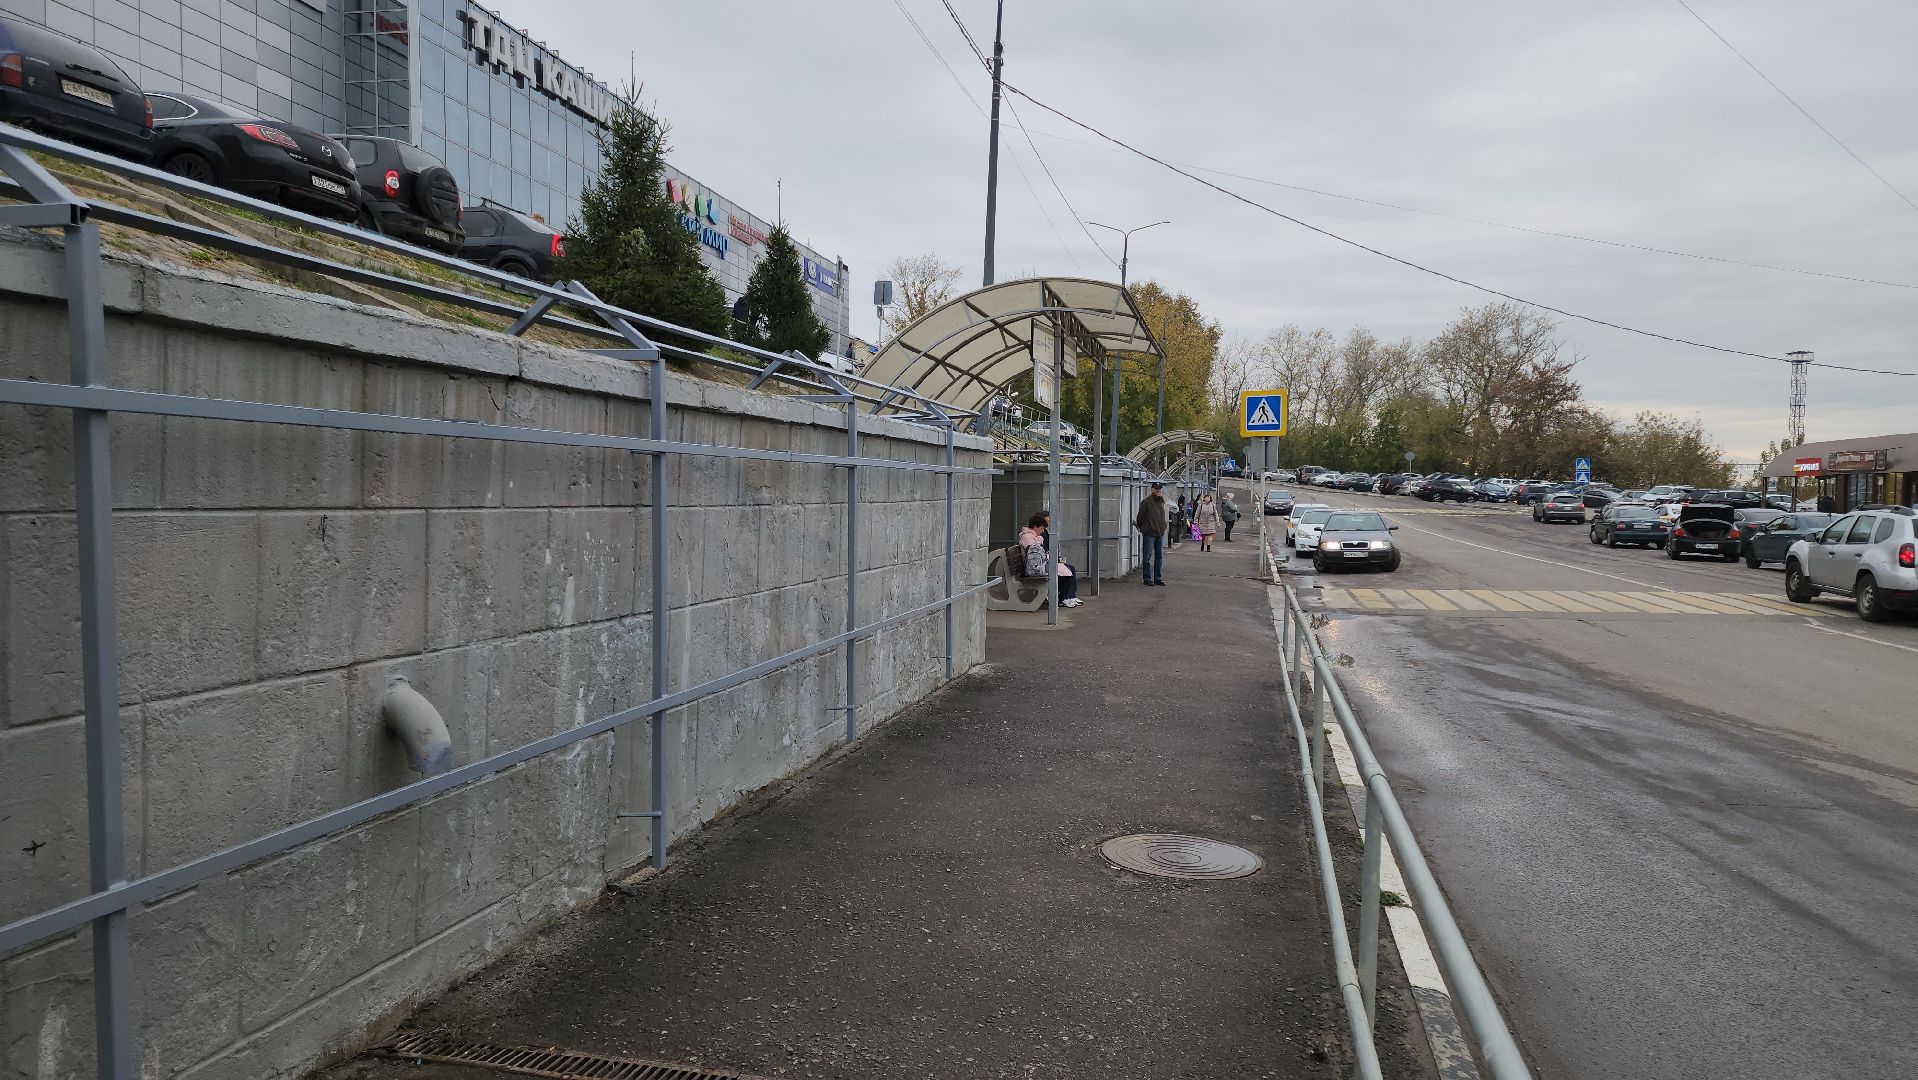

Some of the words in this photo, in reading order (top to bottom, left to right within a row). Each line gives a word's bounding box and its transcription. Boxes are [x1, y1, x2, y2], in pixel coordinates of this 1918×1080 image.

[457, 9, 541, 89] ТДЦ
[541, 54, 613, 130] КАШИ
[702, 227, 729, 260] мир
